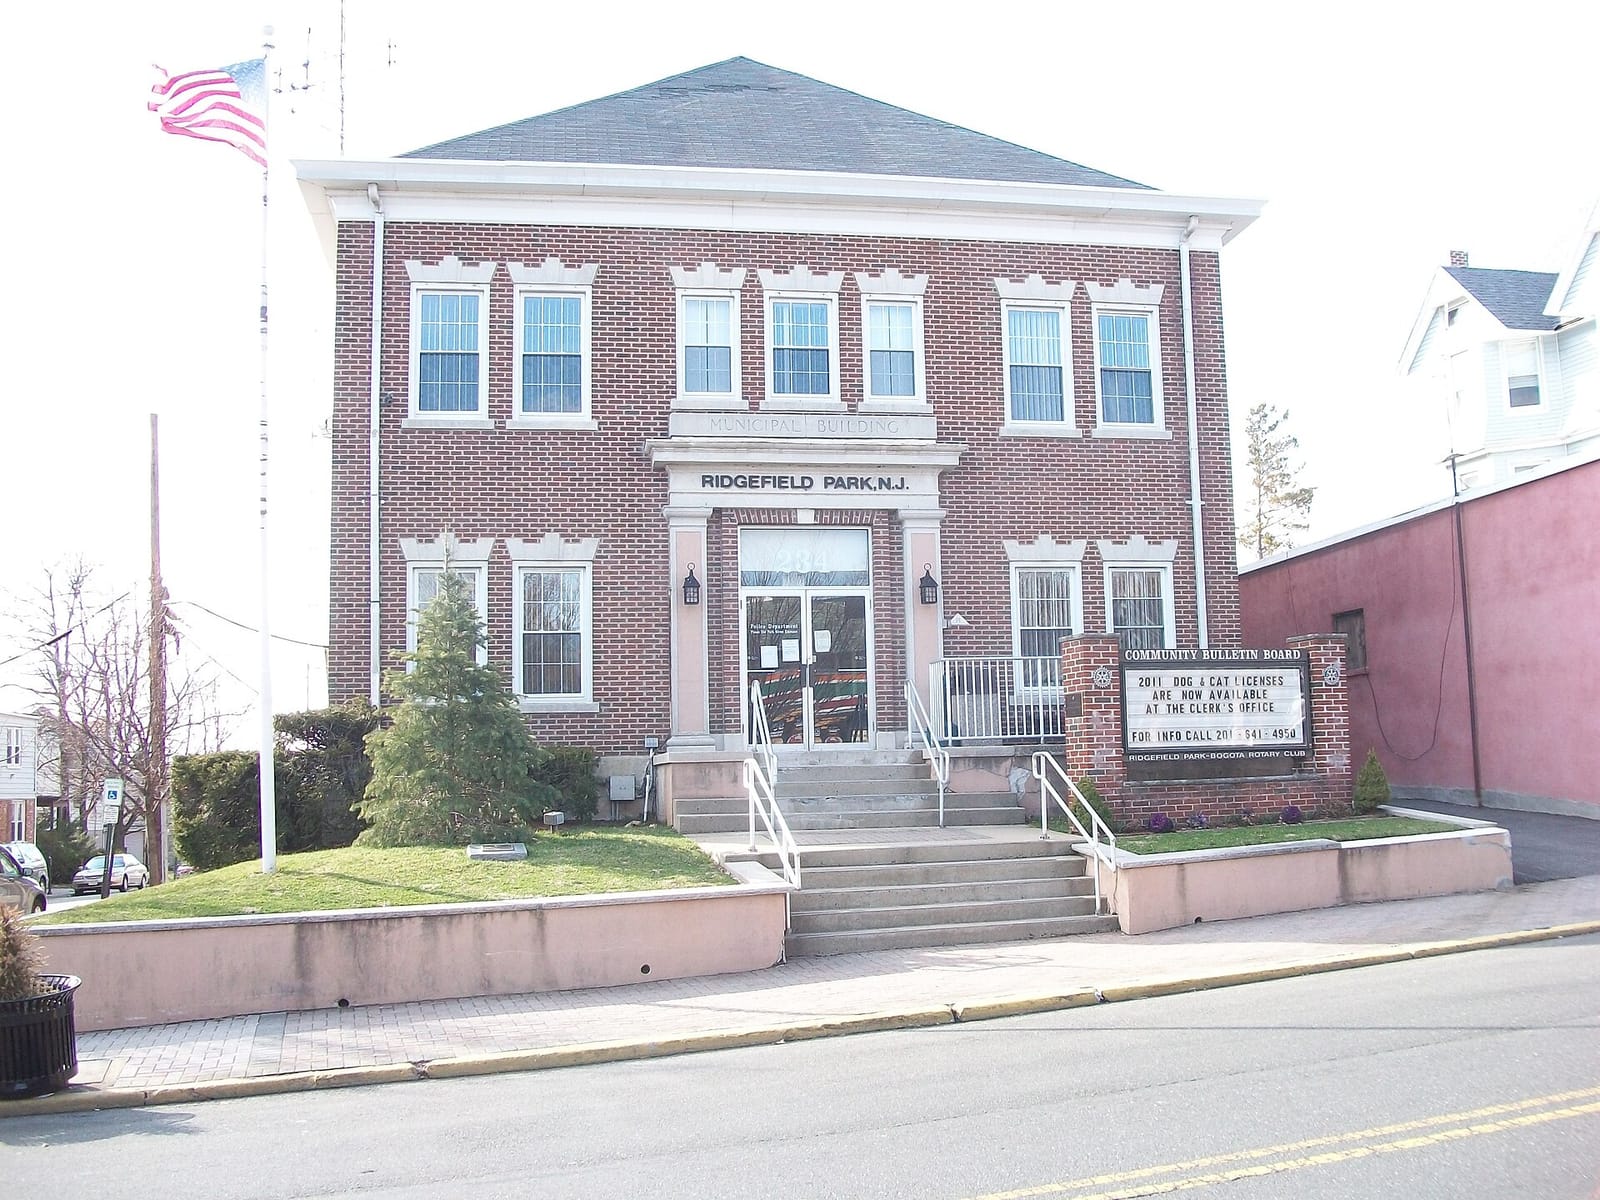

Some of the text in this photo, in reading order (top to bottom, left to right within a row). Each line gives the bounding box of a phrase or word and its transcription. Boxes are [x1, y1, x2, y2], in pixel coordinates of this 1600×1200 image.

[711, 418, 900, 434] MUNICIPAL BUILDING
[701, 475, 814, 490] RIDGEFIELD
[776, 550, 830, 573] 234
[1125, 649, 1301, 661] COMMUNITY BULLETIN BOARD
[1138, 675, 1284, 687] 2011 DOG & CAT LICENSES
[1152, 689, 1268, 701] ARE NOW AVAILABLE
[1145, 702, 1275, 714] AT THE CLERK'S OFFICE
[1132, 731, 1151, 742] FOR
[1157, 730, 1182, 741] INFO
[1185, 730, 1212, 741] CALL
[1129, 753, 1180, 761] RIDGEFIELD
[1183, 752, 1245, 760] PARK-BOGOTA
